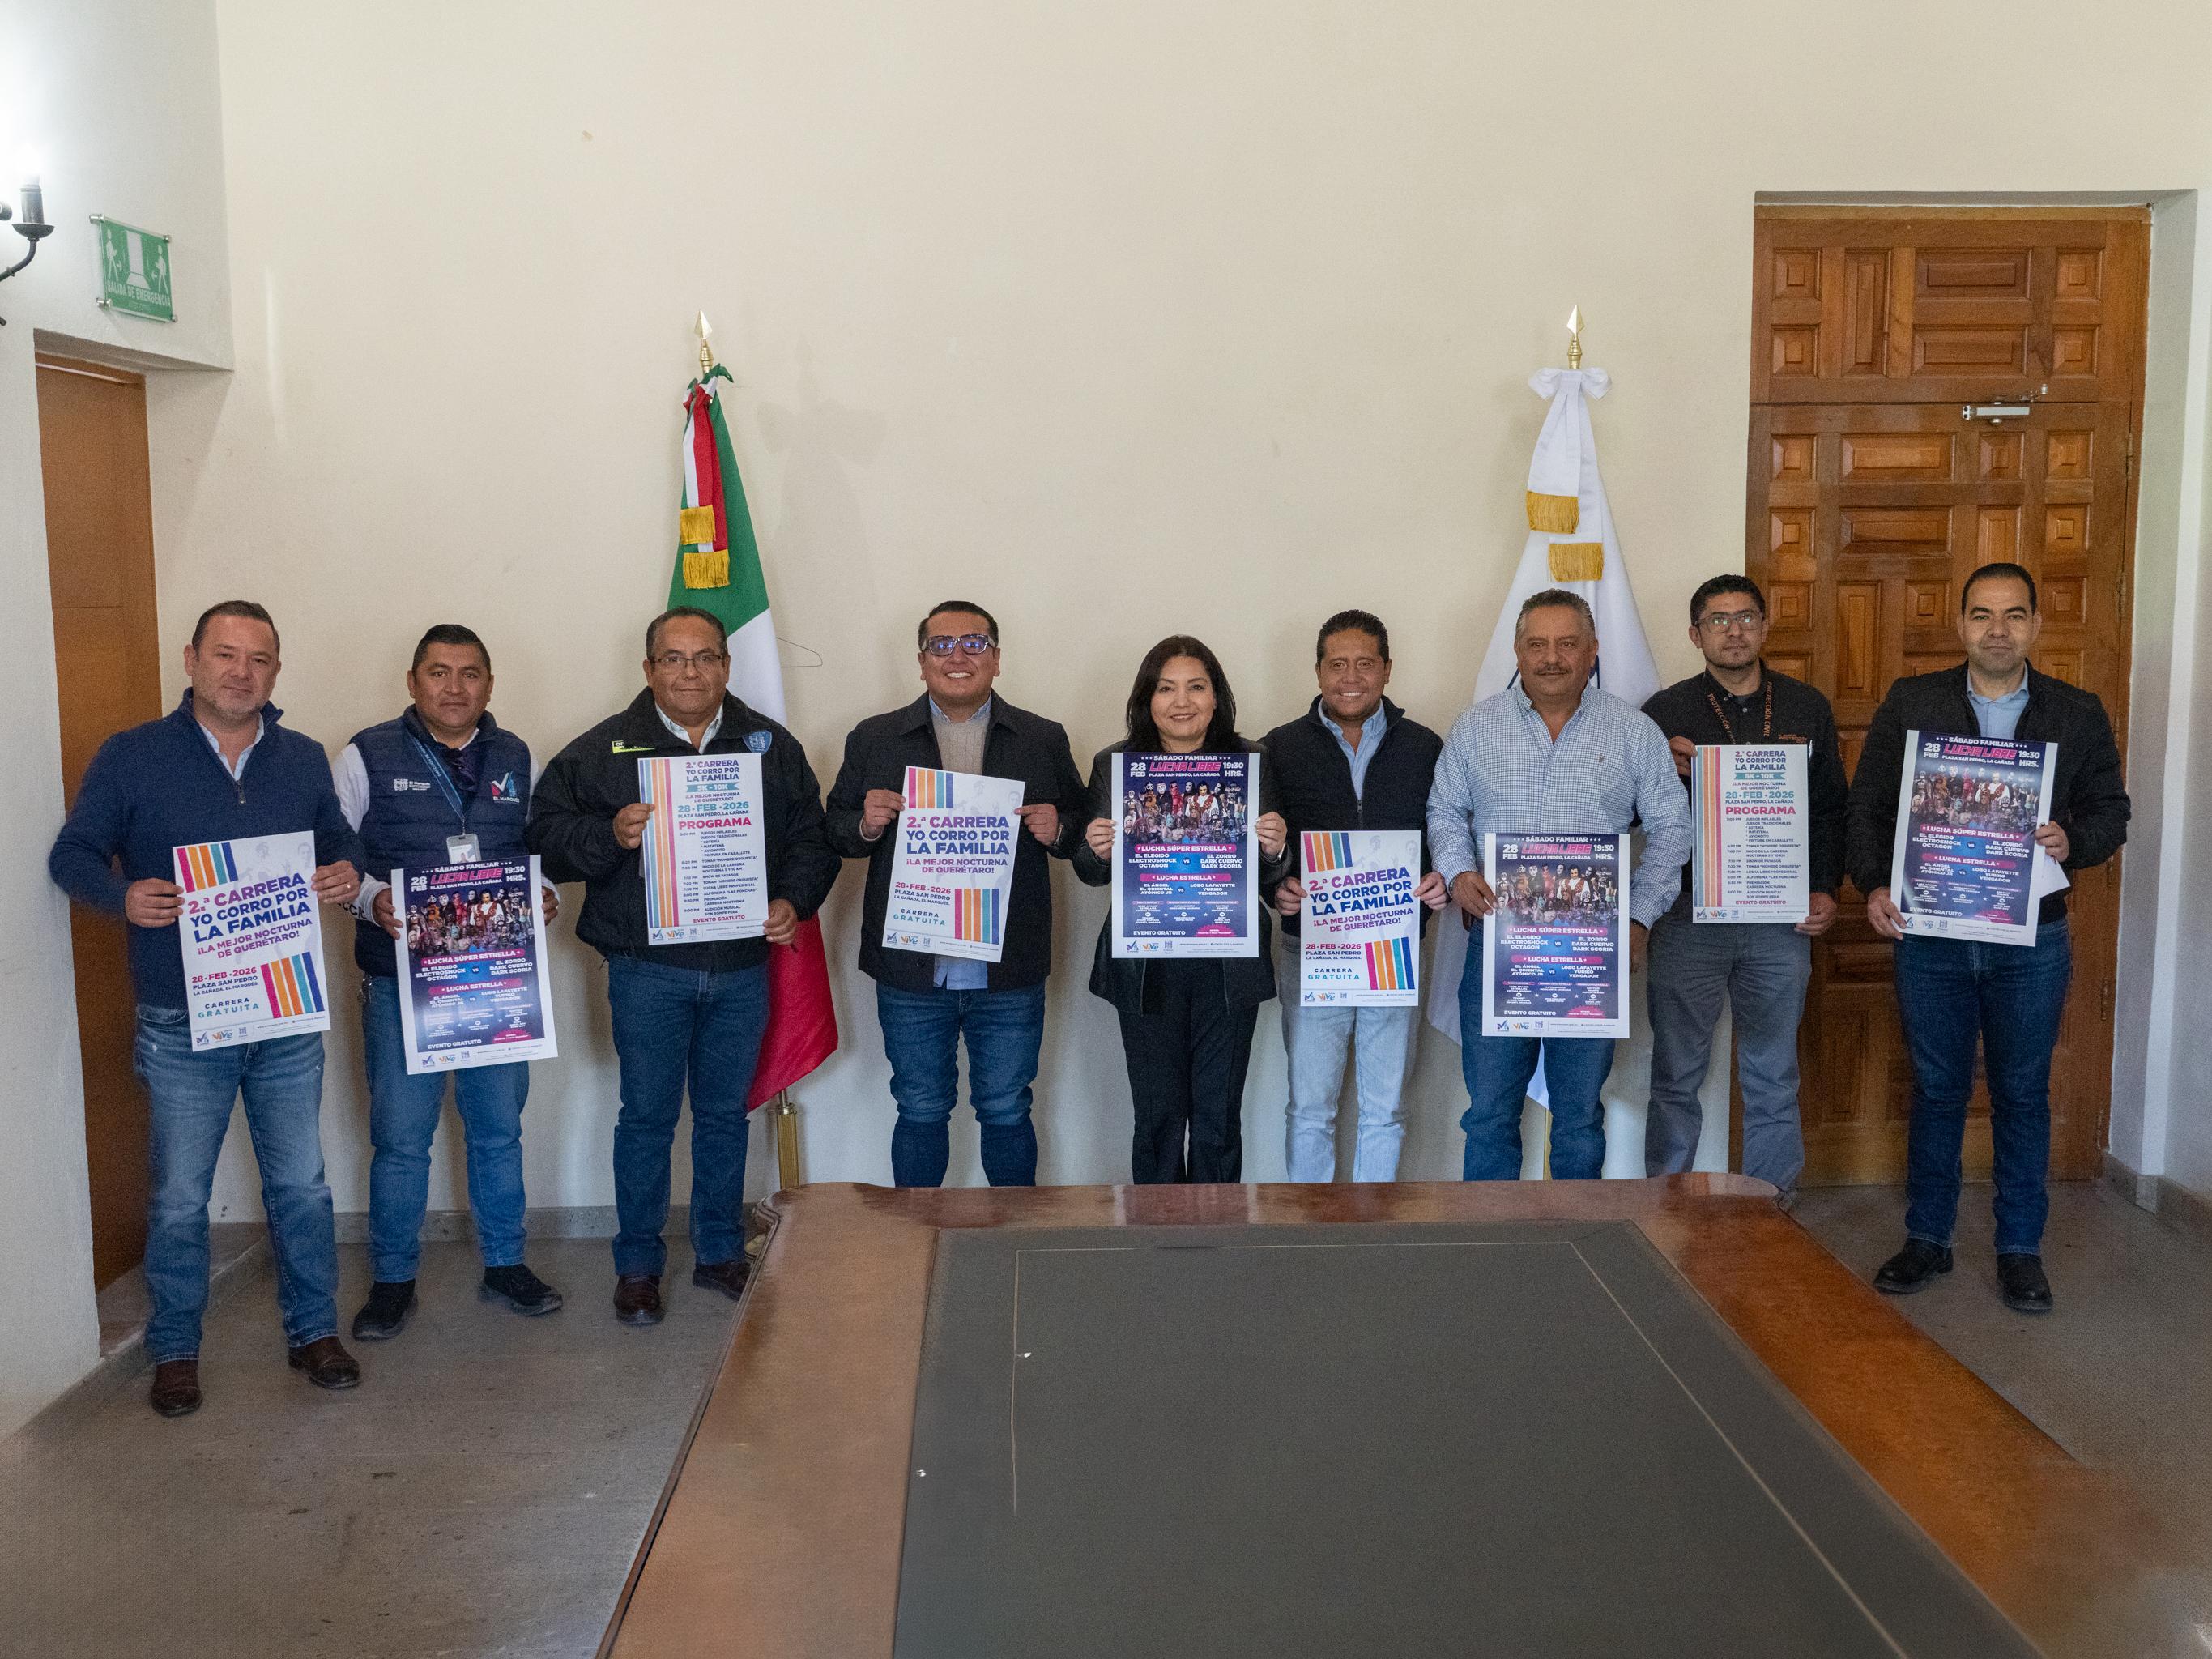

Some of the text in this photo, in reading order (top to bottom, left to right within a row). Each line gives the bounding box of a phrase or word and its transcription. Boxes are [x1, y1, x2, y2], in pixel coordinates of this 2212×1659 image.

[1924, 743, 1940, 753] 28
[1949, 737, 2014, 748] SÁBADO FAMILIAR
[2019, 751, 2041, 759] 19:30
[679, 817, 752, 830] PROGRAMA
[930, 816, 1008, 828] CARRERA
[906, 830, 1009, 840] YO CORRO POR
[907, 842, 1008, 854] LA FAMILIA
[1502, 845, 1518, 853] 28
[433, 864, 463, 872] SÁBADO
[505, 866, 525, 874] 19:30
[410, 876, 427, 885] 28
[1331, 866, 1410, 889] CARRERA
[213, 871, 305, 908] CARRERA
[1310, 880, 1412, 903] YO CORRO POR
[190, 886, 308, 928] YO CORRO POR
[1312, 892, 1413, 916] LA FAMILIA
[901, 909, 939, 918] CARRERA
[1330, 915, 1361, 924] MEJOR
[1363, 908, 1413, 920] NOCTURNA
[194, 899, 311, 942] LA FAMILIA
[893, 914, 945, 926] GRATUITA
[1344, 917, 1401, 930] QUERÉTARO!
[217, 934, 253, 949] MEJOR
[255, 918, 313, 939] NOCTURNA
[218, 930, 300, 958] DE QUERÉTARO!
[193, 982, 216, 990] PLAZA
[234, 975, 258, 983] PEDRO
[204, 997, 249, 1009] CARRERA
[197, 1003, 259, 1018] GRATUITA
